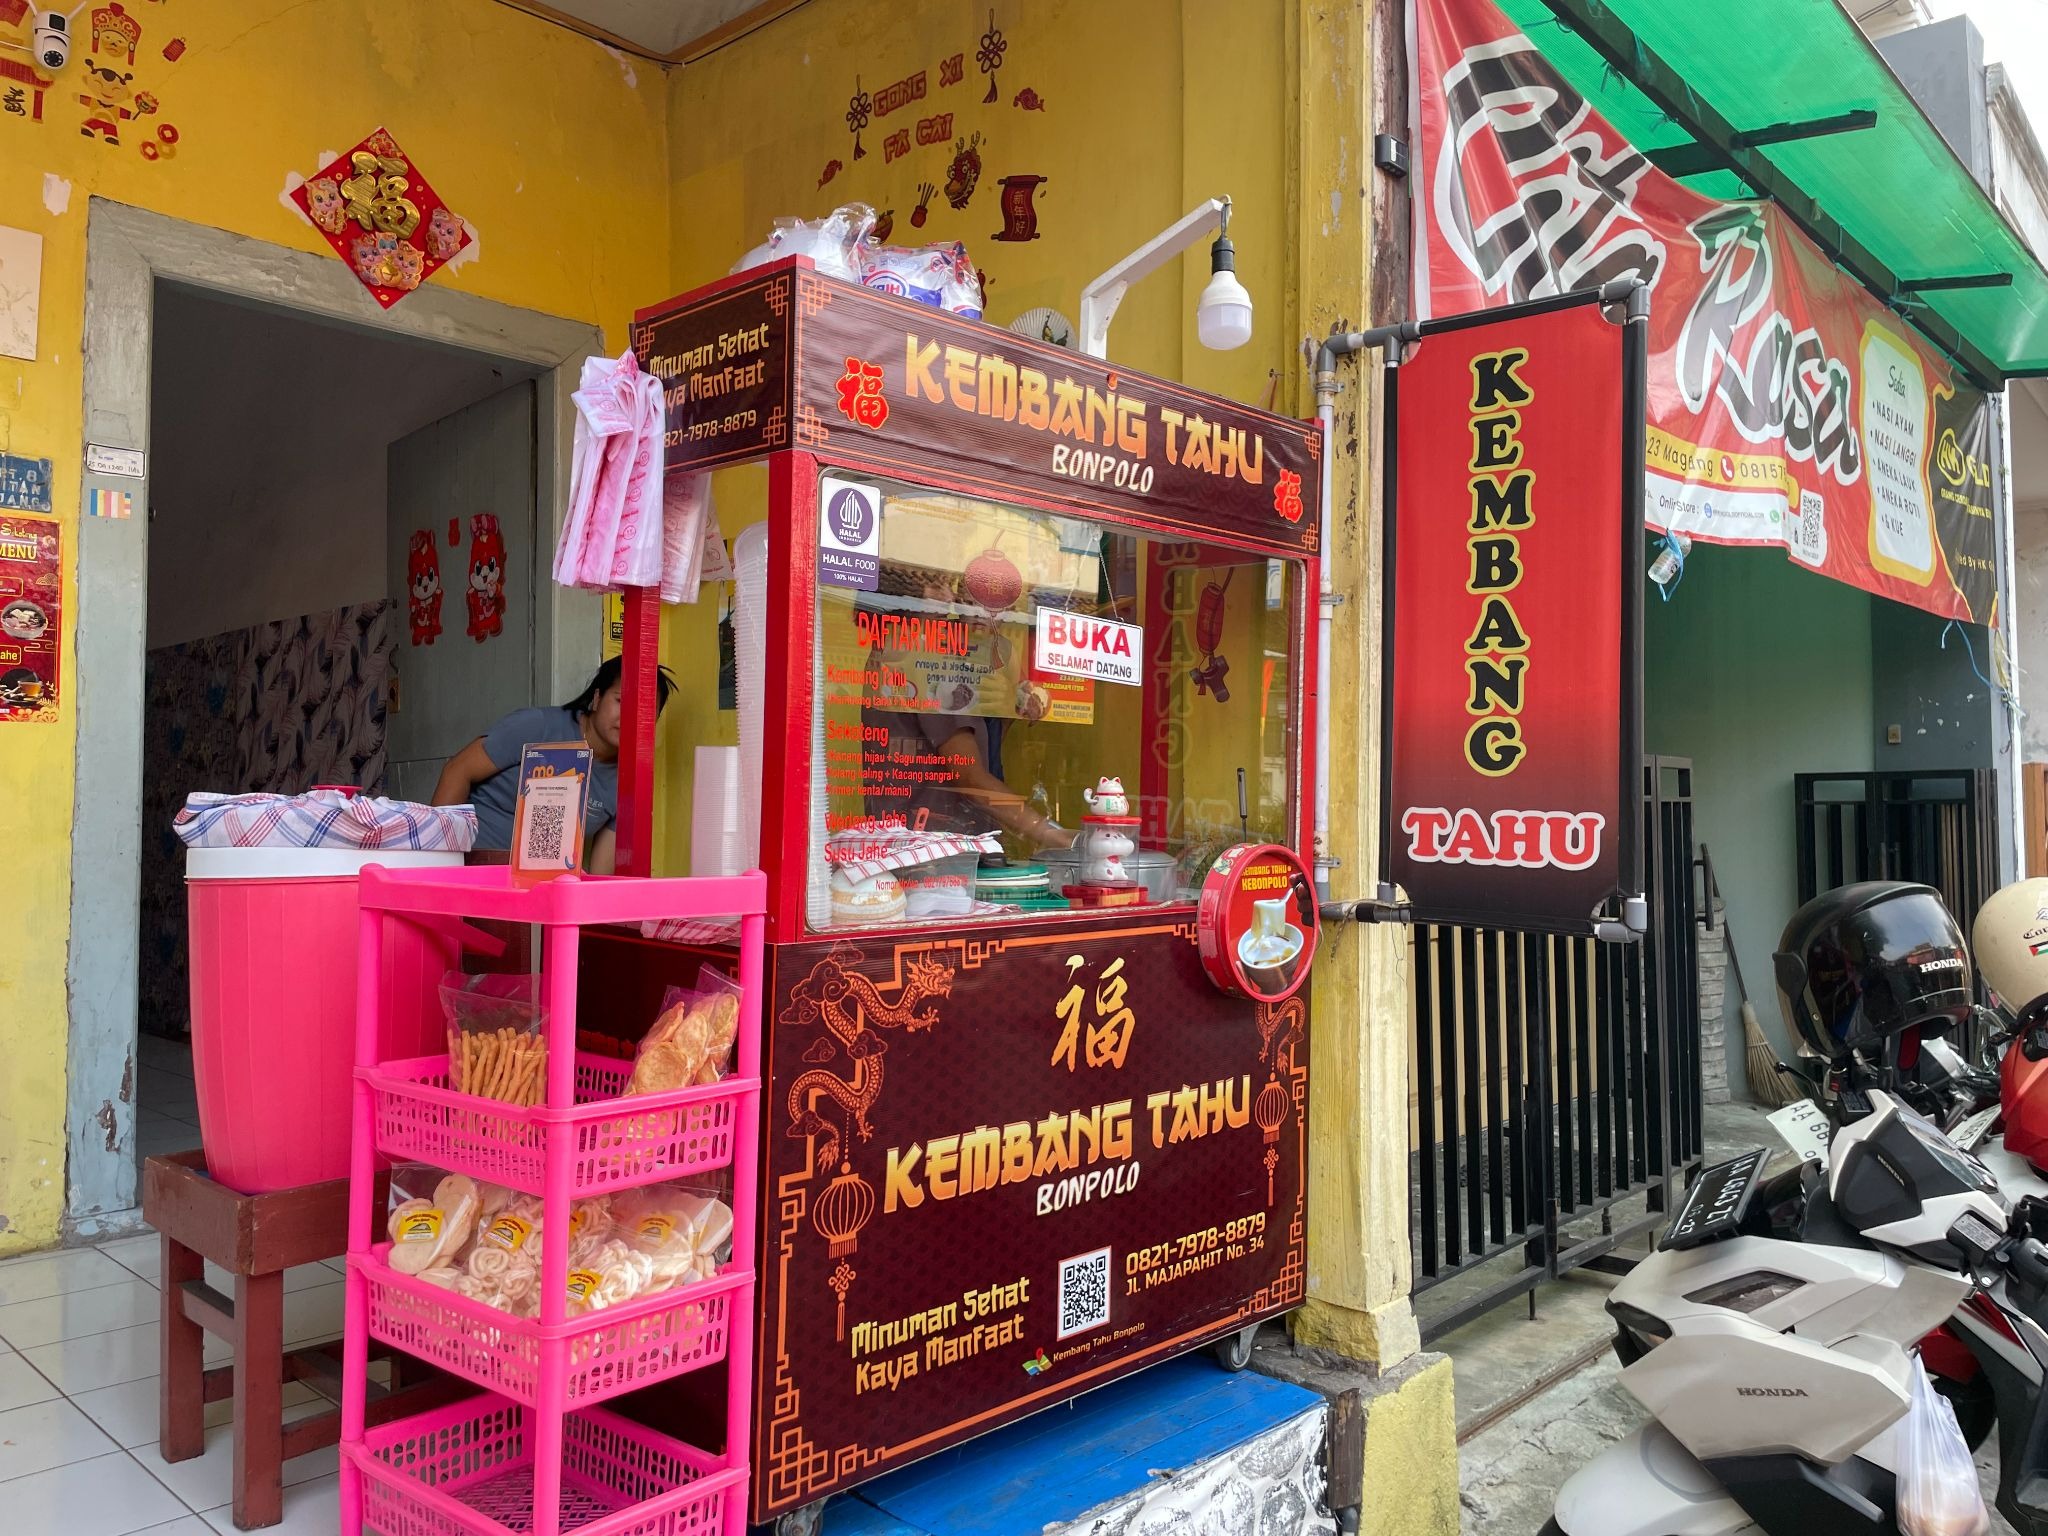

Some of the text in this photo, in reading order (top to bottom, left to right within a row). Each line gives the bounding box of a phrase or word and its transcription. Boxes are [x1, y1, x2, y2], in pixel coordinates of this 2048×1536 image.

[873, 53, 964, 117] GONG XI
[916, 113, 954, 146] CAI
[650, 322, 770, 380] Minuman Sehat
[835, 356, 891, 431] 福
[904, 331, 1264, 486] KEMBANG TAHU
[663, 409, 757, 448] 821-7978-8879
[1876, 402, 1914, 438] NASI AYAM
[1874, 429, 1917, 466] NASI LANGGI
[1052, 443, 1155, 494] BONPOLO
[1273, 467, 1305, 524] 福
[1881, 487, 1921, 519] ANEKA ROTI
[839, 529, 862, 539] HALAL
[1890, 518, 1904, 537] KUE
[822, 553, 876, 571] HALAL FOOD
[847, 574, 864, 584] HALAL
[1464, 346, 1536, 778] KEMBANG
[858, 612, 969, 656] DAFTAR MENU
[1049, 615, 1131, 657] BUKA
[0, 650, 18, 661] ahe
[1048, 653, 1132, 678] SELAMAT DATANG
[827, 664, 907, 690] Kembang Tahu
[826, 720, 889, 747] Sekoteng
[864, 750, 885, 765] hijau
[893, 752, 915, 766] Sagu
[916, 753, 946, 765] mutiara
[892, 768, 923, 783] Kacang
[924, 770, 954, 783] sangrai
[878, 810, 907, 829] Jahe
[825, 840, 888, 862] Susu Jahe
[1401, 806, 1606, 871] TAHU
[1242, 865, 1287, 877] EMBANG TAHU
[1242, 876, 1288, 891] KEBONPOLO
[1920, 957, 1964, 973] HONDA
[1051, 954, 1136, 1073] 福
[883, 1074, 1252, 1214] KEMBANG TAHU
[1036, 1161, 1140, 1217] BONPOLO
[1126, 1211, 1267, 1276] 0821-7978-8879
[1126, 1235, 1265, 1296] Jl. MAJAPAHIT No. 34
[851, 1276, 1030, 1359] Minuman Sehat
[1053, 1322, 1145, 1363] Kembang Tahu Bonpolo
[855, 1352, 919, 1396] Kaya
[1736, 1386, 1809, 1399] HONDA
